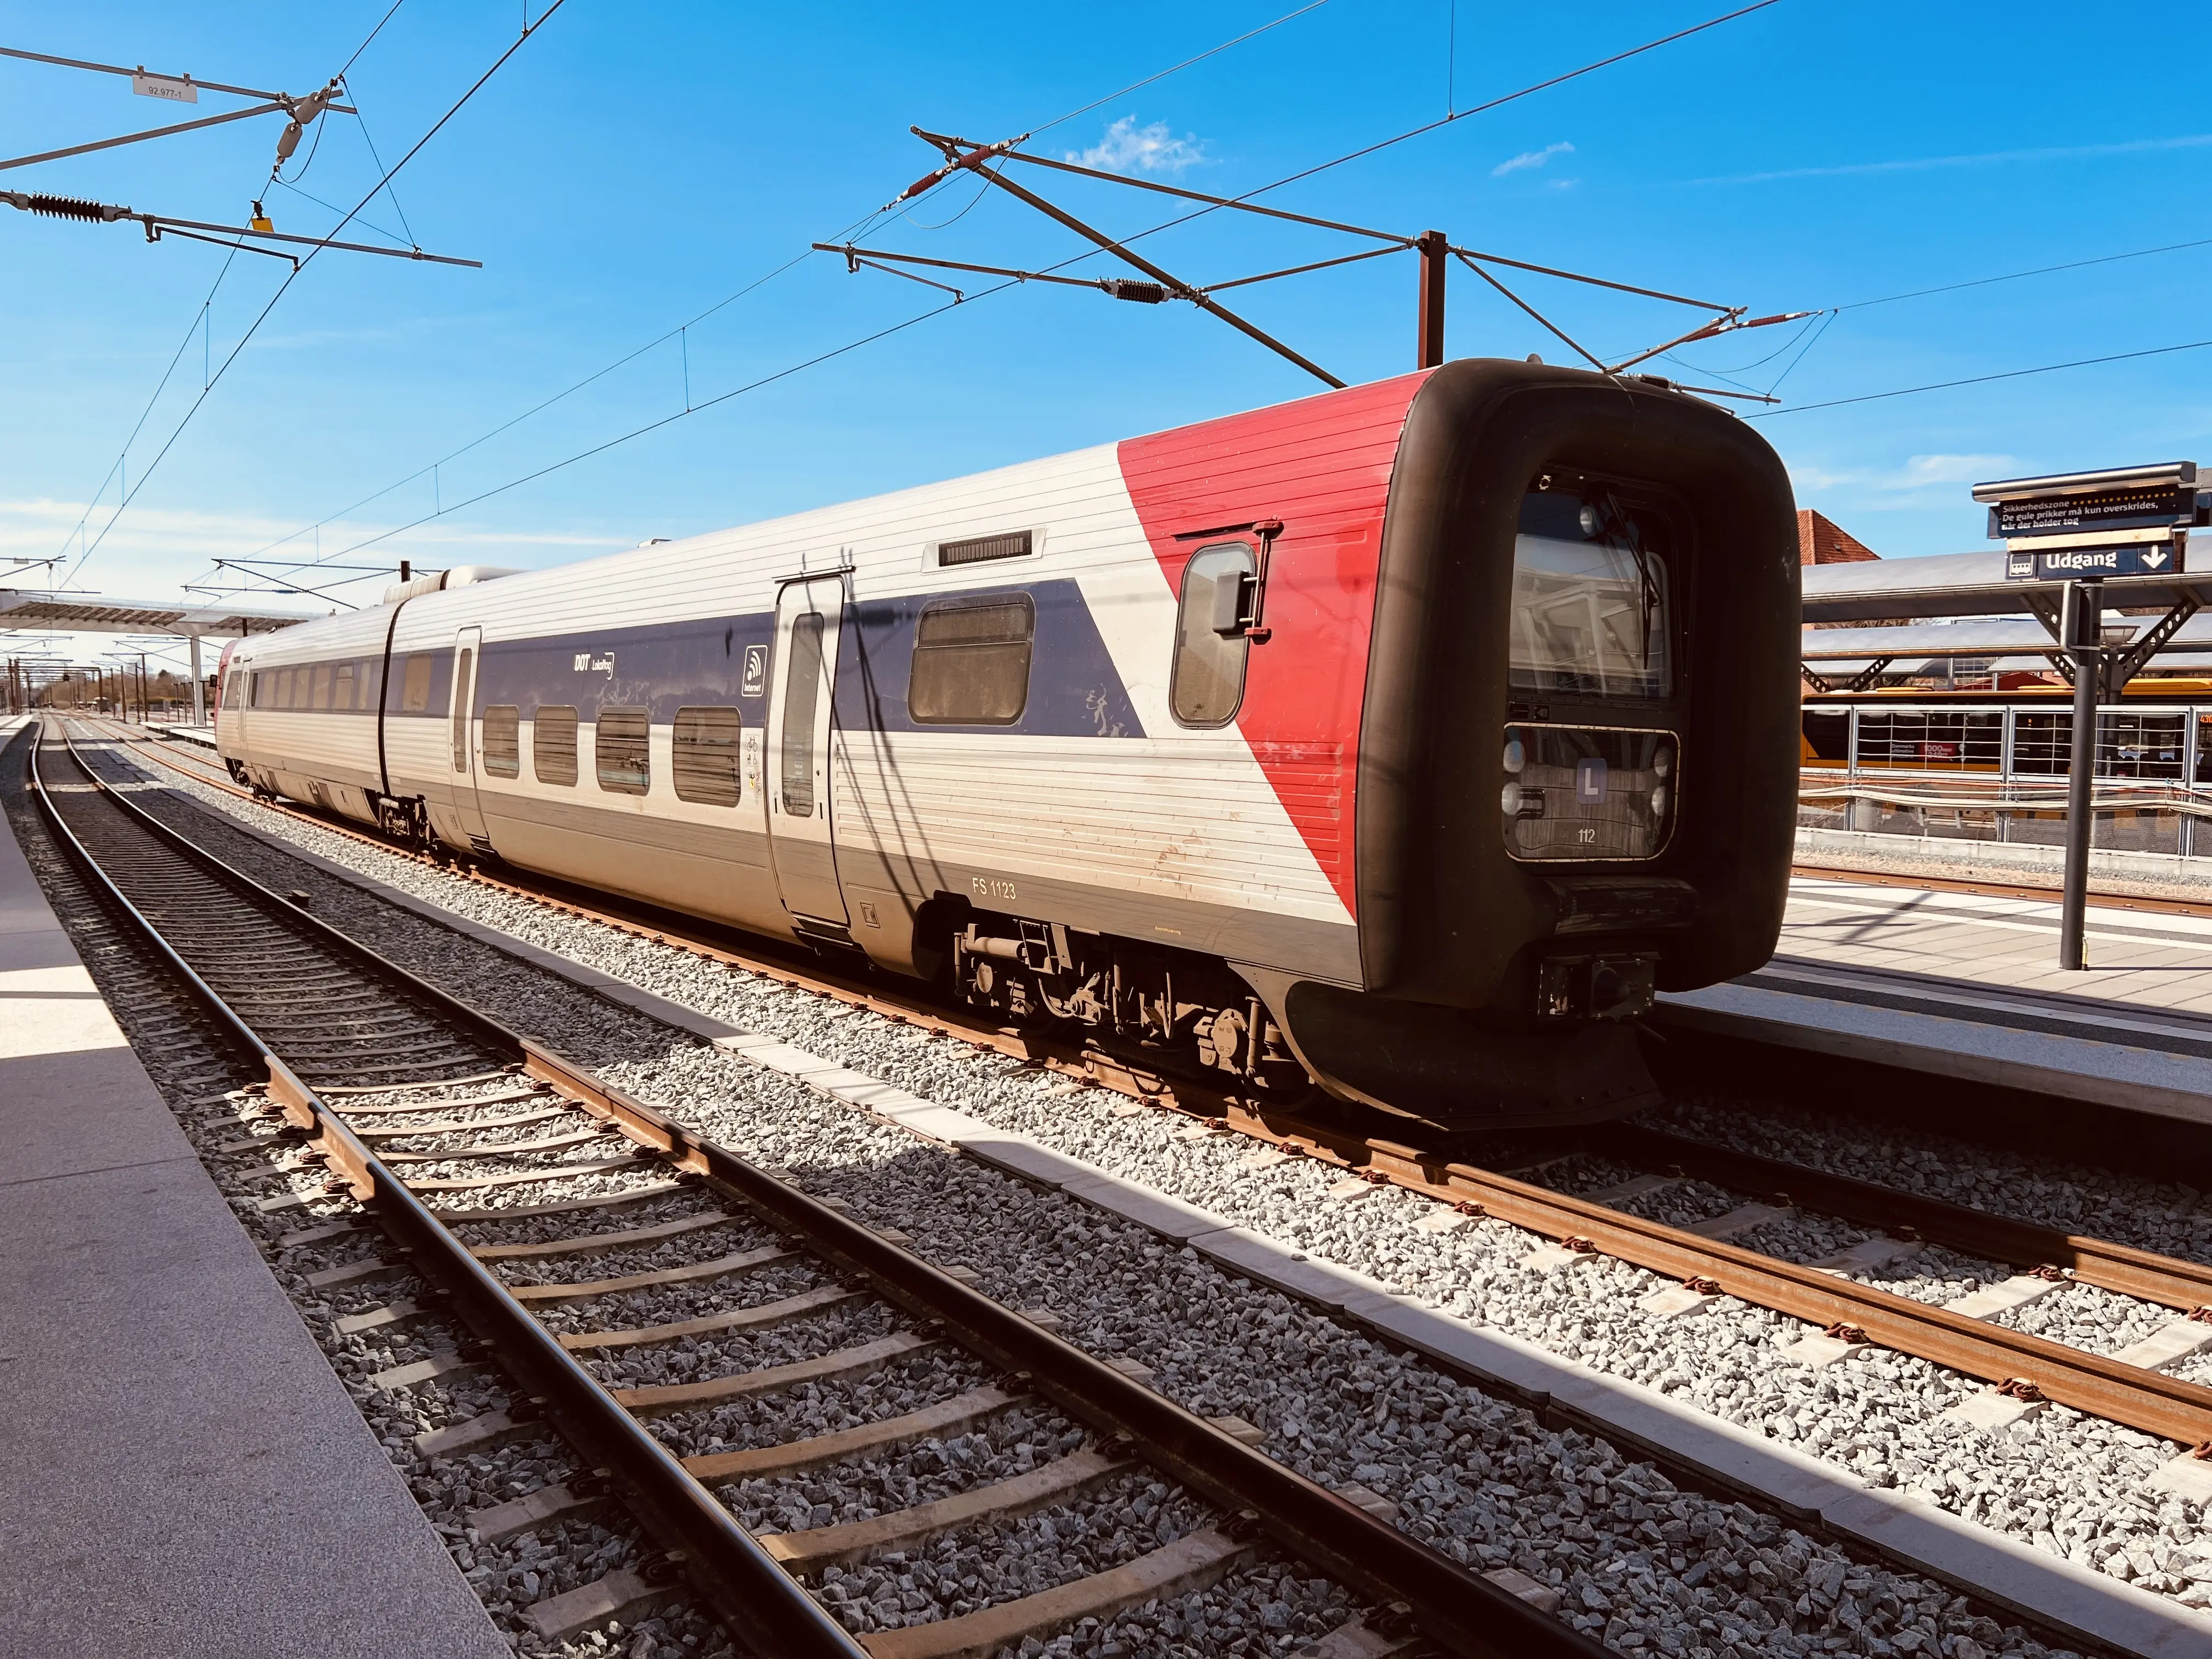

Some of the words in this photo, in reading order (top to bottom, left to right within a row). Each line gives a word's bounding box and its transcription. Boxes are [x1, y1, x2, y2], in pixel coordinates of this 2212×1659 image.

[2002, 501, 2070, 513] Sikkerhedszone
[2016, 512, 2034, 521] gule
[2036, 510, 2067, 519] prikker
[2068, 507, 2082, 516] må
[2085, 506, 2101, 515] kun
[2103, 501, 2158, 513] overskrides,
[2033, 519, 2061, 528] holder
[2062, 517, 2079, 526] tog
[2046, 551, 2117, 571] Udgang
[574, 653, 591, 672] DOT
[592, 658, 612, 674] Lokaltog
[744, 683, 761, 692] Internet
[1584, 768, 1599, 795] L
[1578, 828, 1595, 843] 112
[972, 877, 988, 895] FS
[990, 880, 1017, 900] 1123
